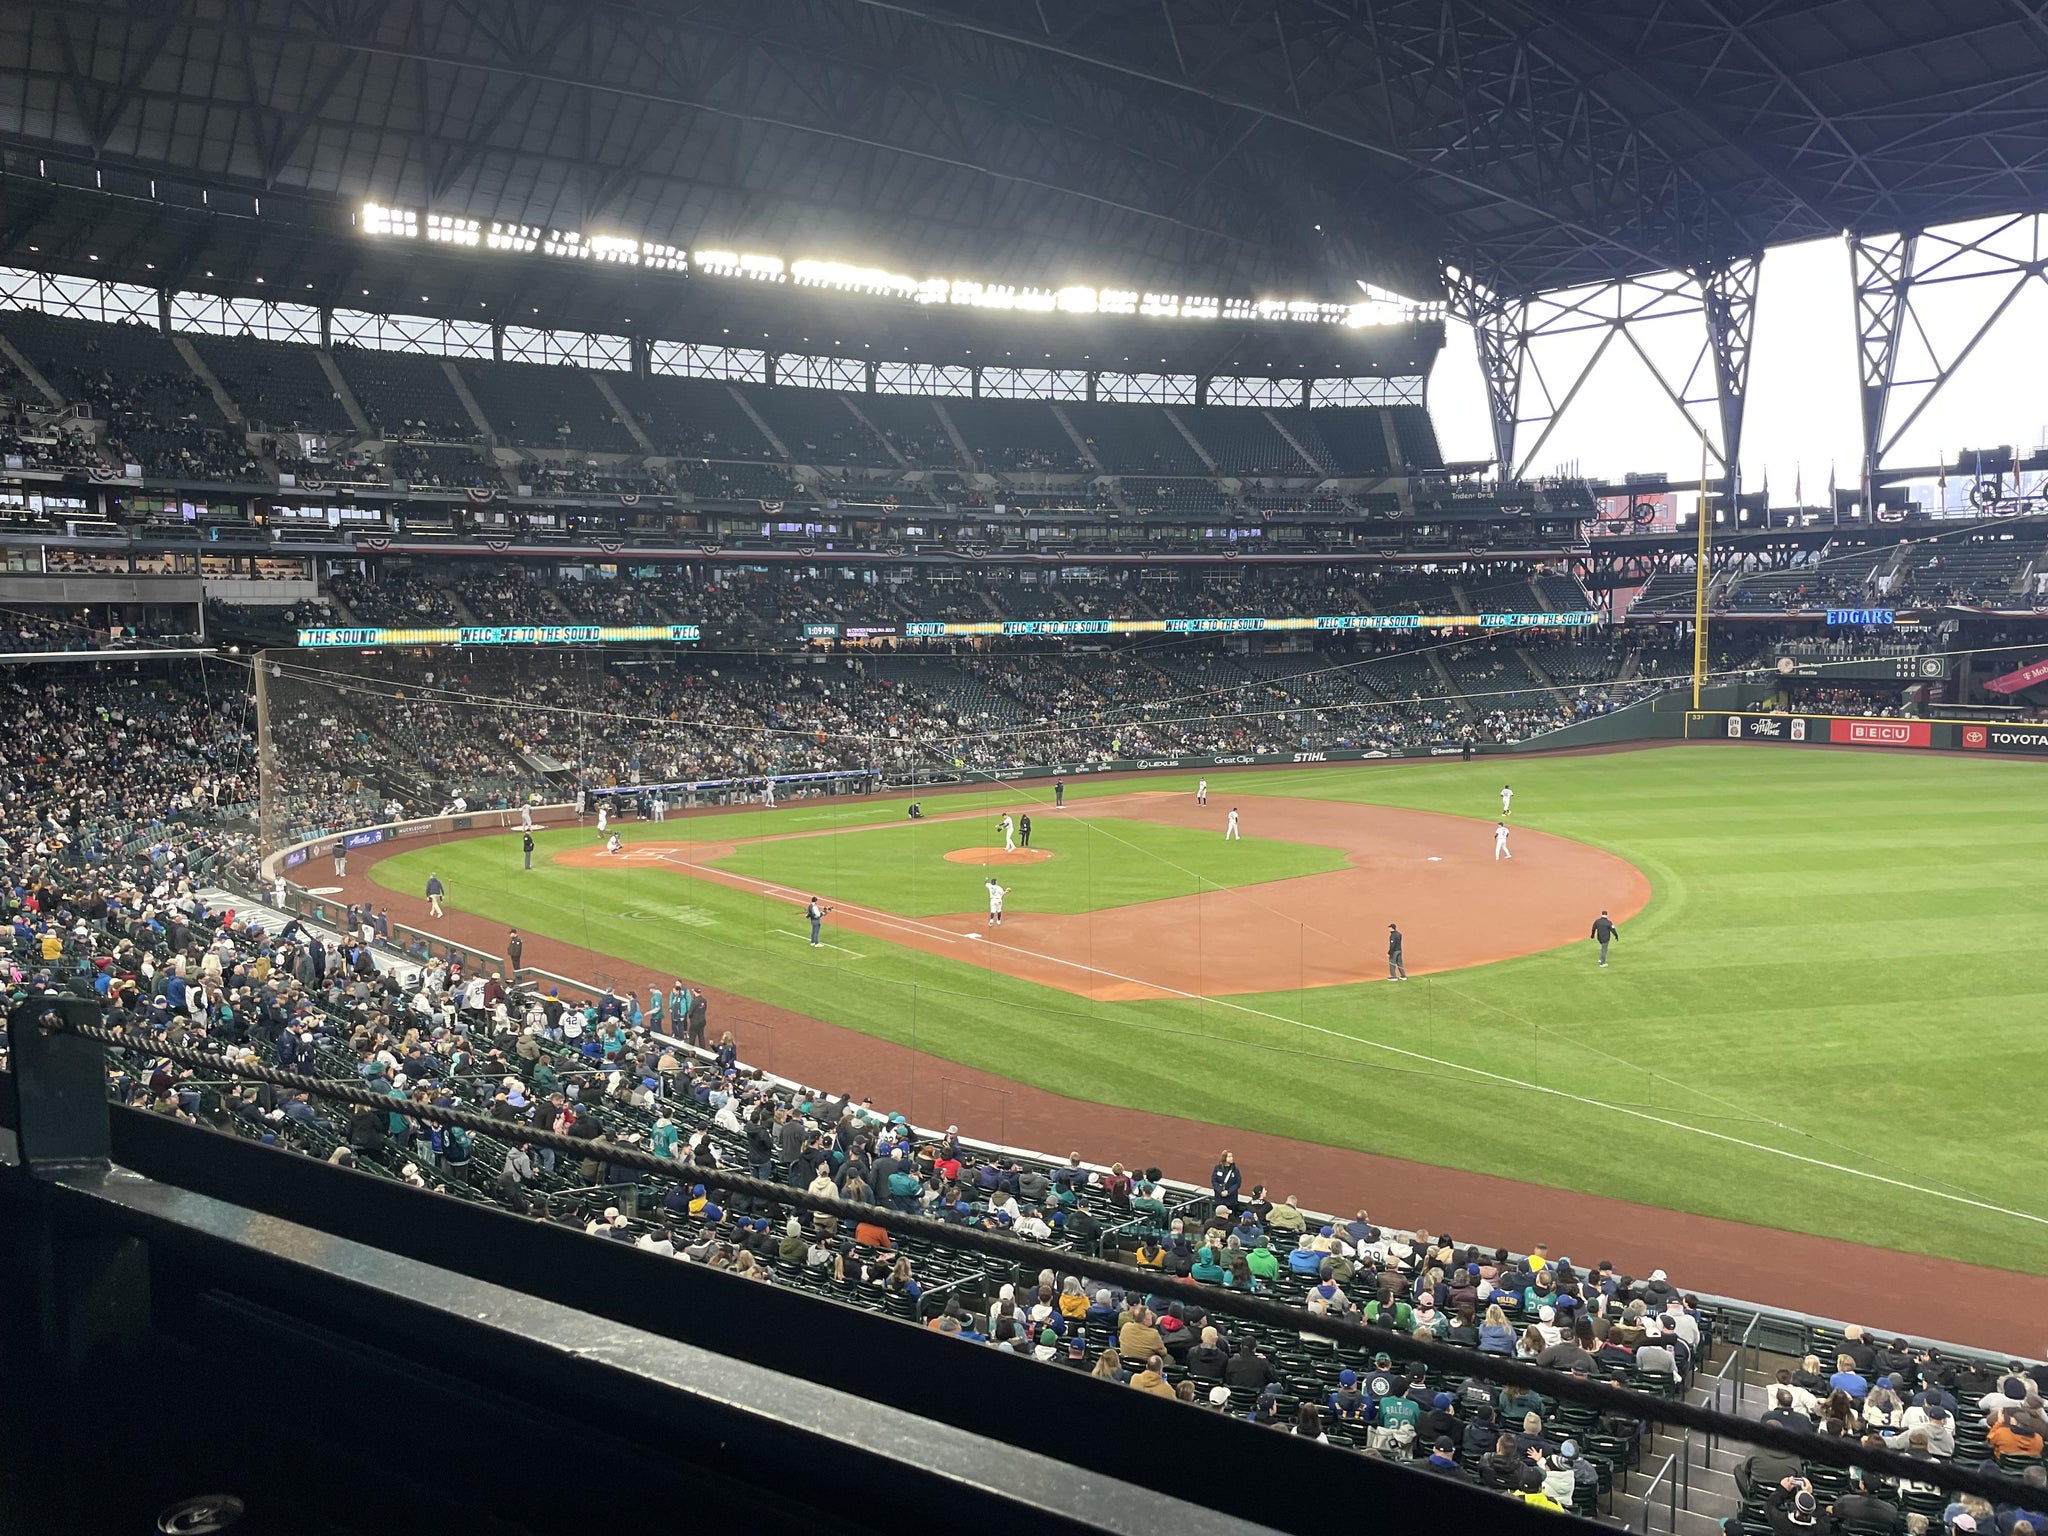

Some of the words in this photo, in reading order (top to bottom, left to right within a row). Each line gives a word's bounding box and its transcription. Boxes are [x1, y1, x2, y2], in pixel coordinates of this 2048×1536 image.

[1317, 618, 1355, 629] WELCME
[1358, 618, 1368, 628] TO
[1371, 617, 1386, 628] THE
[1389, 617, 1418, 627] SOUND
[1480, 614, 1526, 626] WELCME
[1527, 614, 1539, 625] TO
[1542, 614, 1560, 625] THE
[1562, 613, 1592, 625] SOUND
[1827, 611, 1893, 625] EDGAR'S
[807, 627, 823, 635] 1:09
[823, 627, 835, 635] PM
[917, 624, 945, 635] SOUND
[1002, 622, 1046, 634] WELCME
[1048, 622, 1060, 633] TO
[1062, 622, 1079, 633] THE
[1080, 621, 1109, 632] SOUND
[1165, 620, 1208, 631] WELCME
[1209, 620, 1219, 630] TO
[1221, 620, 1235, 630] THE
[1238, 619, 1265, 629] SOUND
[308, 629, 331, 644] THE
[335, 629, 377, 644] SOUND
[460, 628, 518, 644] WELCME
[522, 628, 536, 641] TO
[540, 628, 560, 641] THE
[563, 627, 601, 641] SOUND
[1691, 714, 1705, 722] 331
[1992, 733, 2048, 746] TOYOTA
[1214, 756, 1236, 764] Great
[1237, 755, 1255, 765] Clips
[1293, 752, 1327, 763] STIHL
[565, 1016, 578, 1025] 42
[653, 1135, 664, 1148] 44
[1385, 1405, 1414, 1417] RALEIGH
